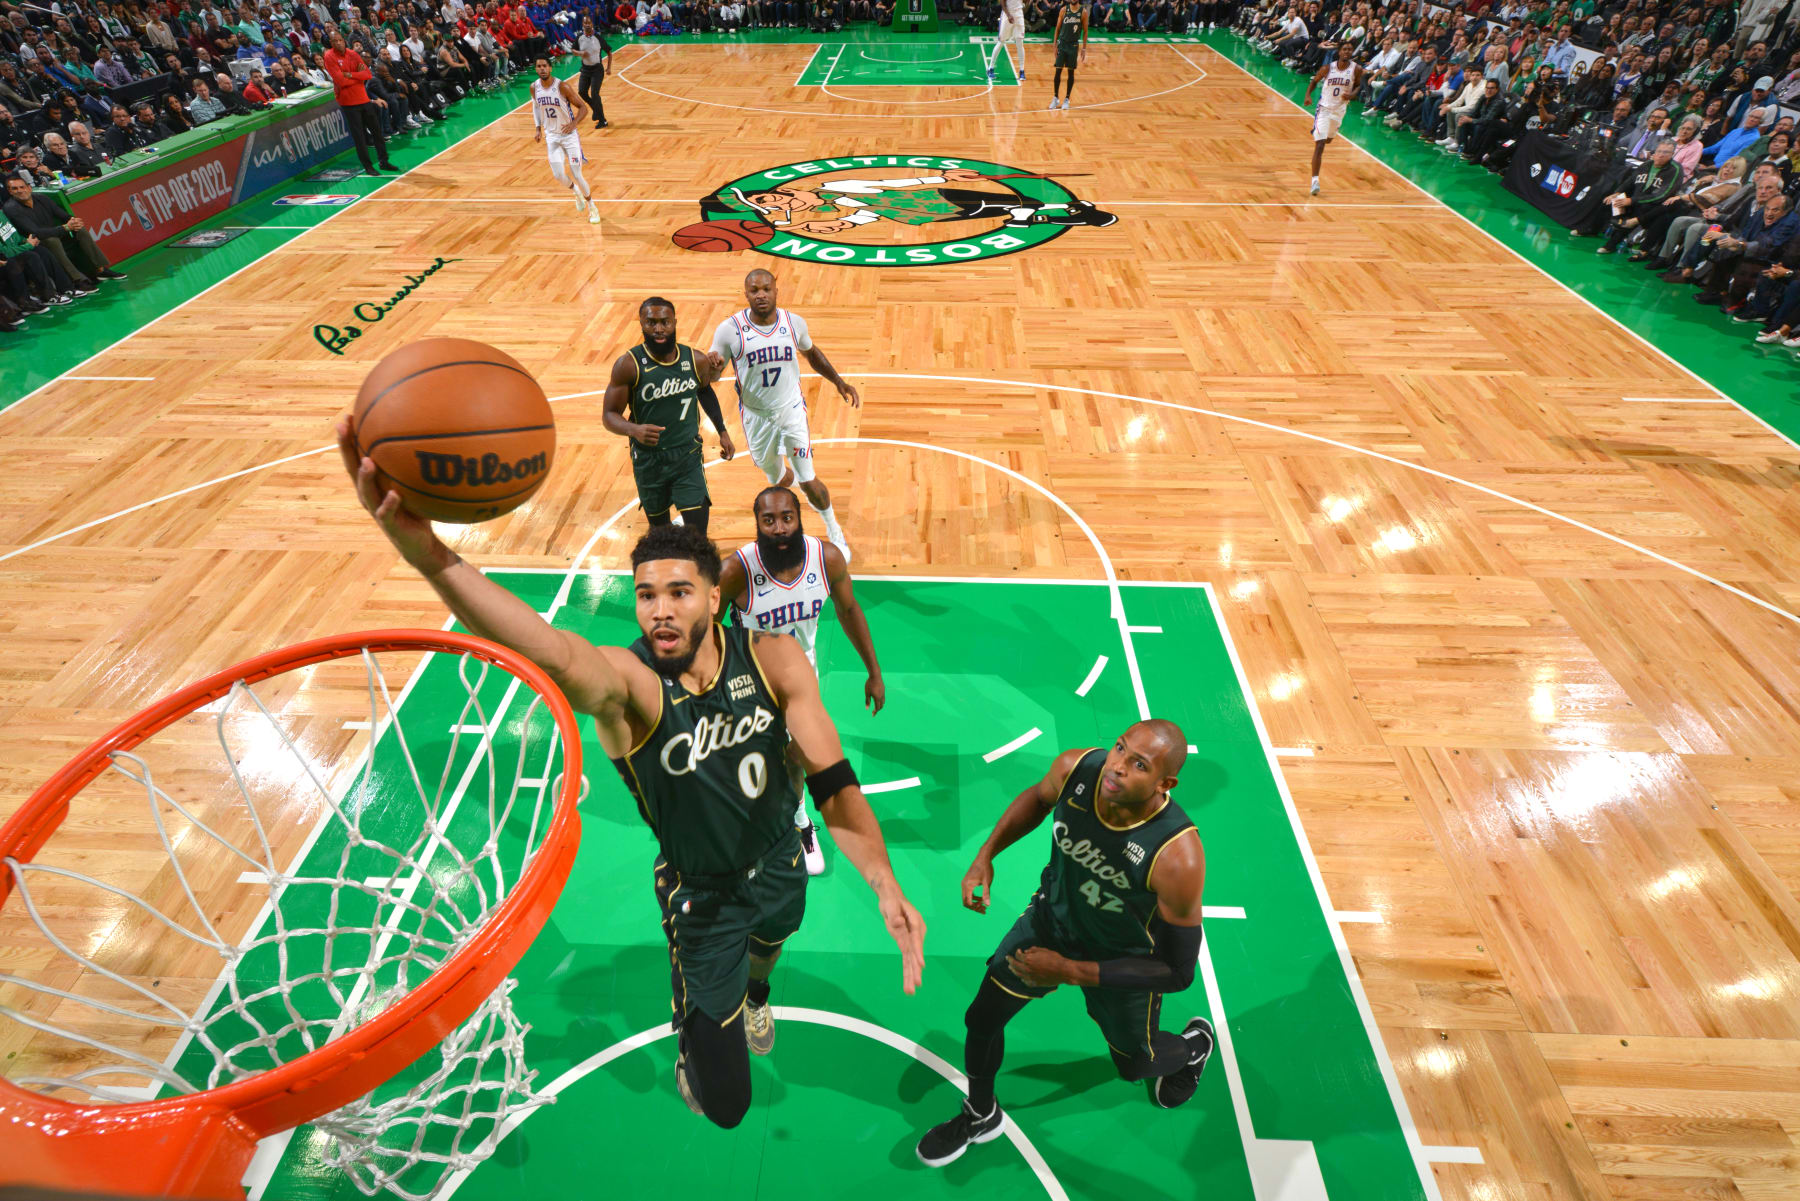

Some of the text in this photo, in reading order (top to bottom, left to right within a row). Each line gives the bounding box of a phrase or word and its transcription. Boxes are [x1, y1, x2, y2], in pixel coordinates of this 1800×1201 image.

[1073, 24, 1079, 34] 9
[1328, 78, 1350, 86] PHILA
[1333, 88, 1340, 97] 0
[537, 97, 560, 107] PHILA
[545, 108, 557, 119] 12
[321, 109, 349, 145] 2022
[764, 157, 963, 180] CELTICS
[143, 173, 195, 224] TIP-OFF
[191, 160, 232, 204] 2022
[771, 233, 1026, 263] BOSTON
[746, 345, 793, 368] PHILA
[761, 367, 781, 388] 17
[641, 377, 697, 402] Celtics
[679, 398, 692, 421] 7
[793, 447, 806, 459] 76
[414, 450, 547, 487] Wilson
[756, 599, 823, 630] PHILA
[728, 674, 755, 691] VISTA
[731, 684, 757, 701] PRINT
[660, 705, 775, 776] Cltics
[738, 752, 767, 799] 0
[1075, 783, 1085, 795] 6
[1053, 821, 1131, 889] Celtics
[1121, 848, 1141, 866] PRINT
[1127, 841, 1146, 858] VISTA
[1078, 879, 1124, 913] 42
